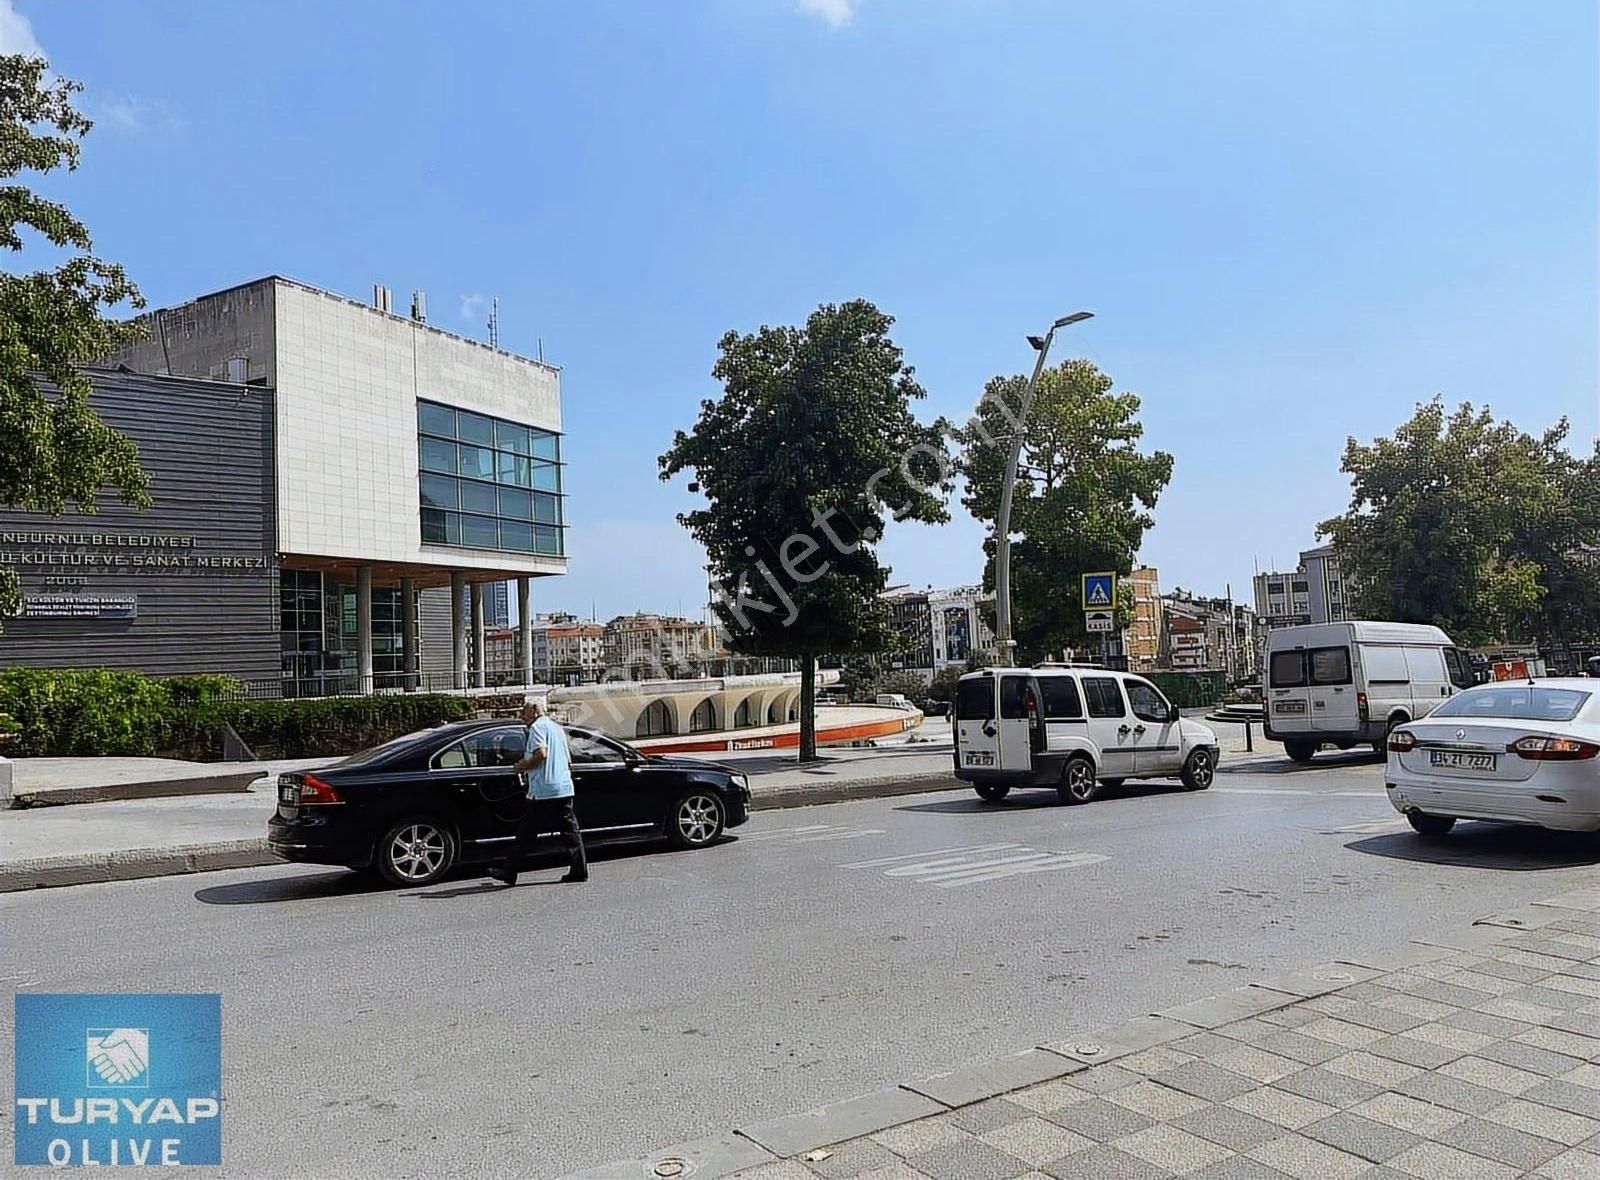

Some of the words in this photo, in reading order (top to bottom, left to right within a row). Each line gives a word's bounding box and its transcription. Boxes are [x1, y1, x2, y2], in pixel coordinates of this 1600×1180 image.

[104, 554, 129, 566] VE
[133, 555, 190, 567] SANAT
[197, 555, 268, 568] MERKEZİ
